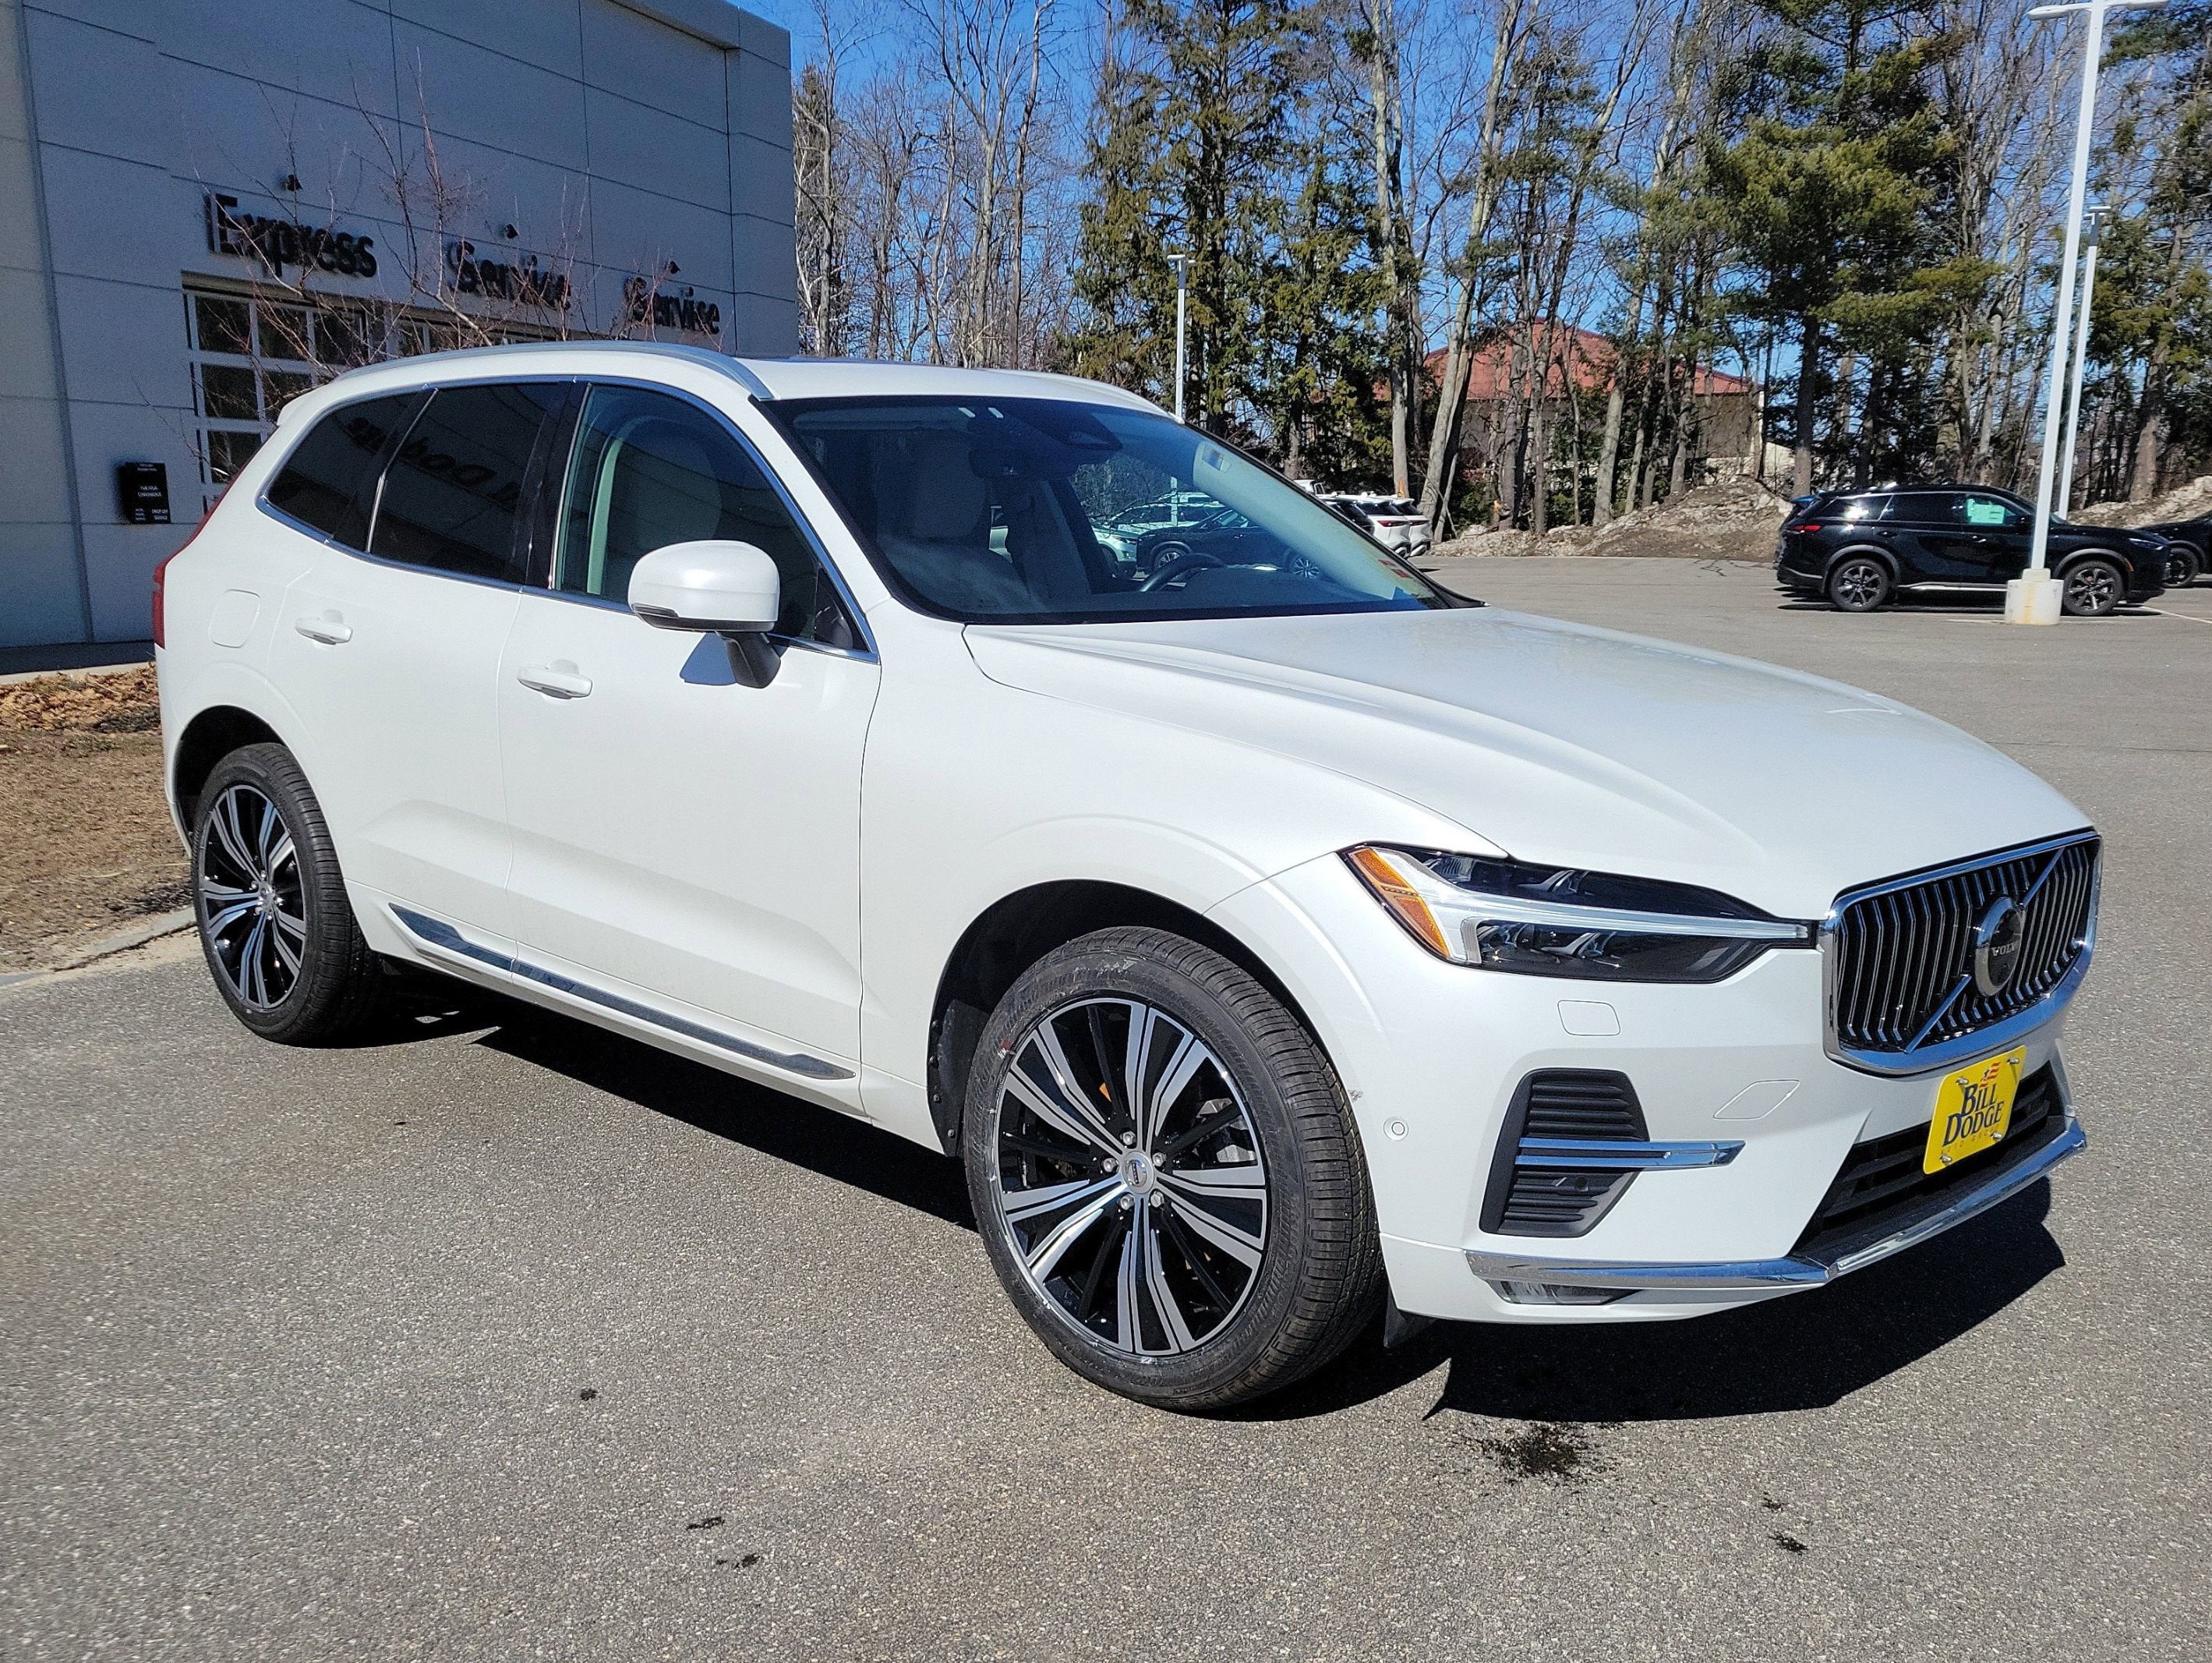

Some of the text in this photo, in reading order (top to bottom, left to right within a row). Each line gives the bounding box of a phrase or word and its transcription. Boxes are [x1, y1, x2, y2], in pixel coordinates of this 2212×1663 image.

[204, 194, 571, 310] Express Service
[626, 277, 719, 334] Service
[1991, 941, 2019, 957] VOLV
[1960, 1083, 1997, 1117] BILL
[1942, 1101, 2004, 1148] DODGE
